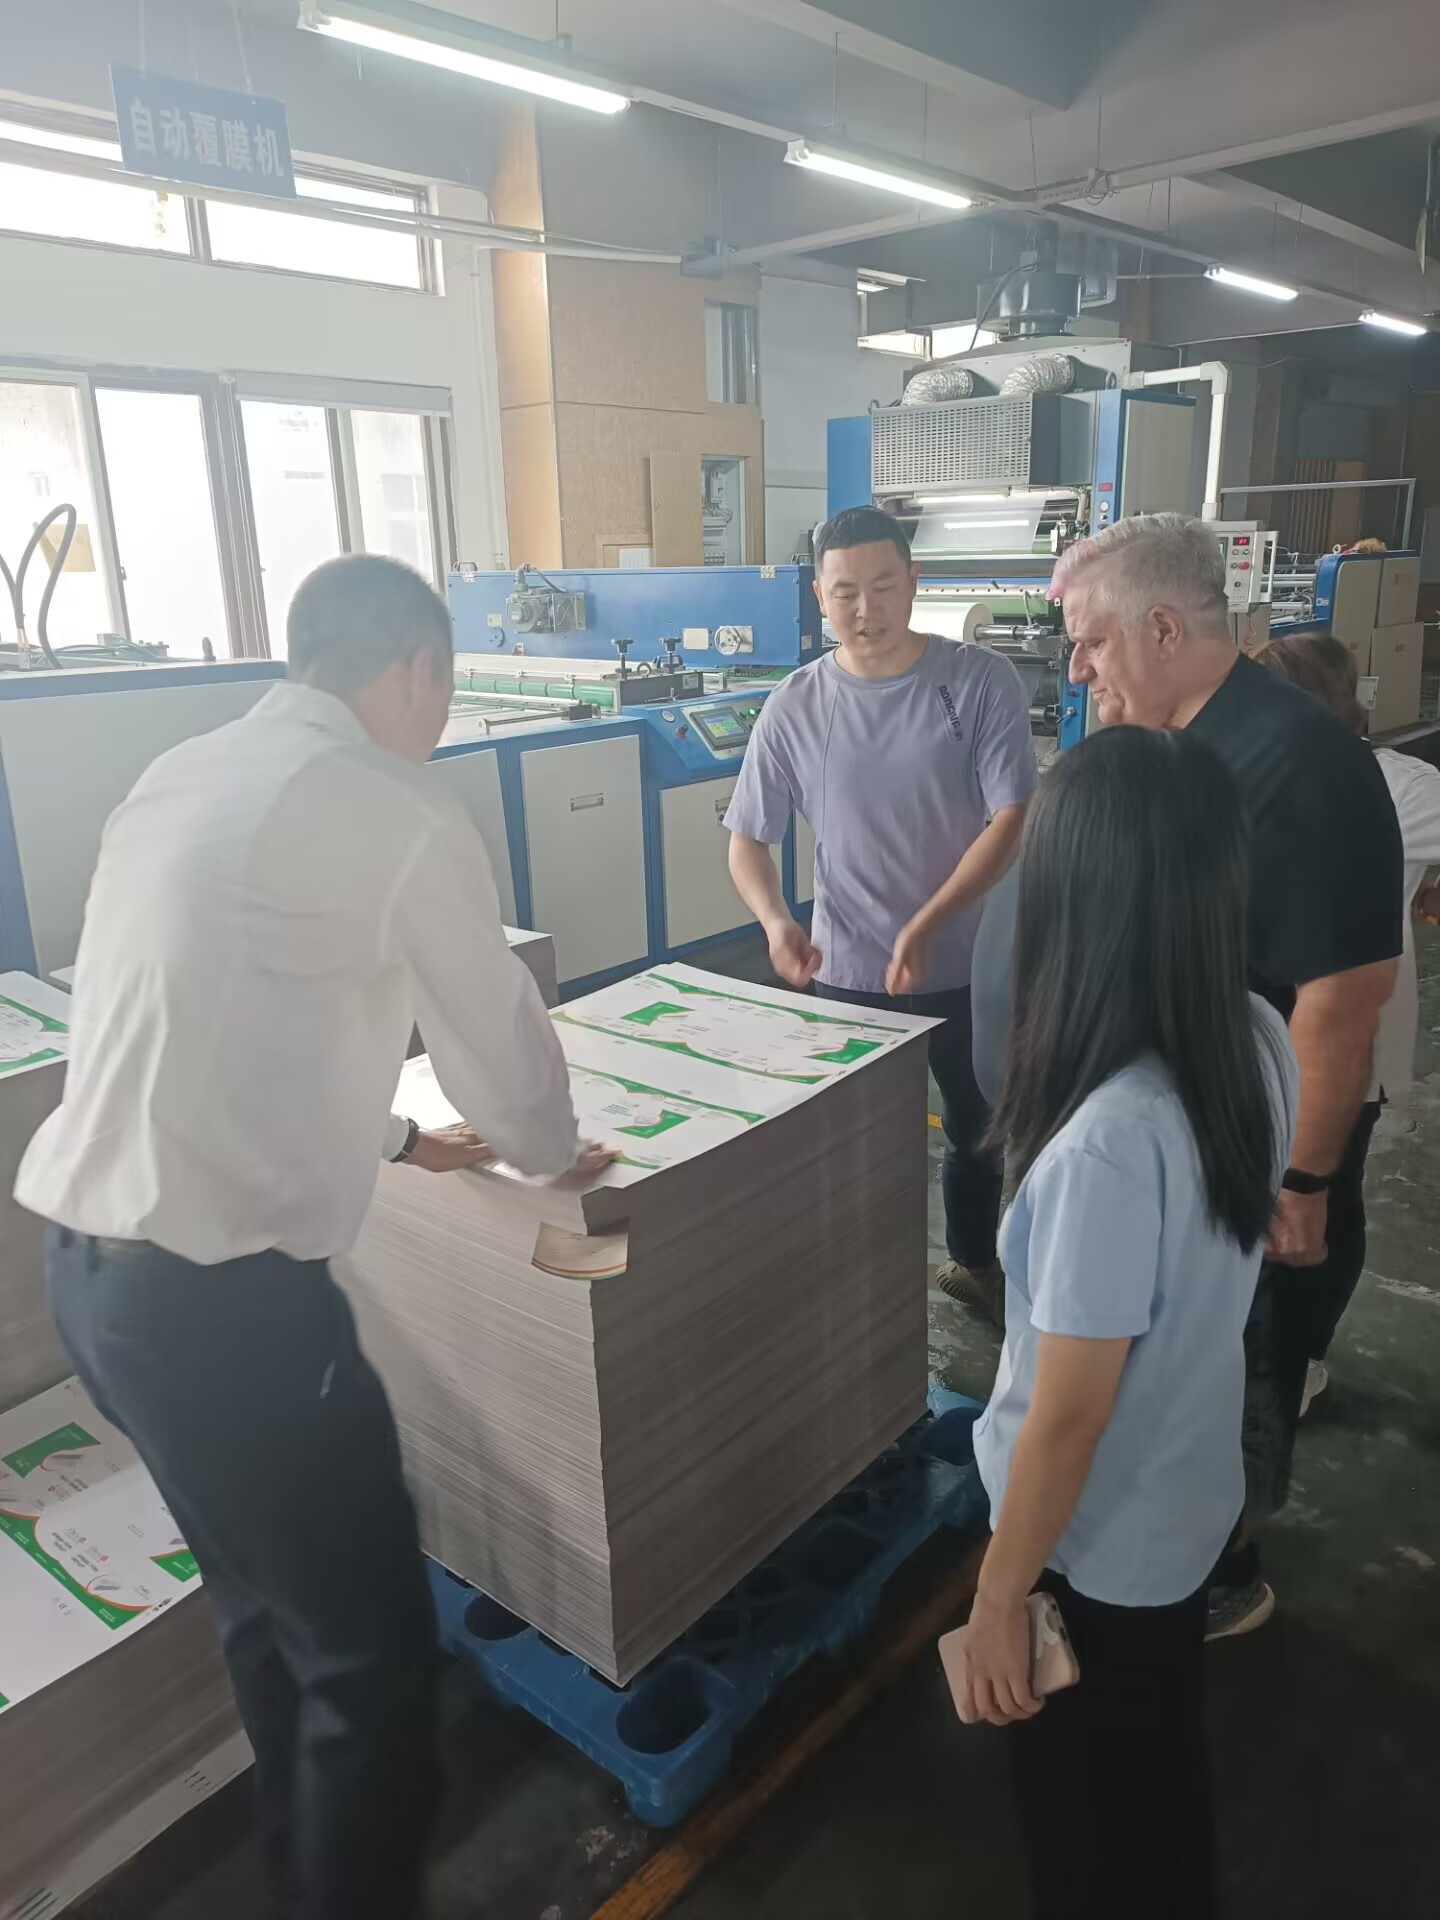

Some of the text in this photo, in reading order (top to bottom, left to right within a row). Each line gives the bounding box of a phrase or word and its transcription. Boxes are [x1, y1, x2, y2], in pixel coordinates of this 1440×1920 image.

[130, 97, 285, 177] 自动覆膜机
